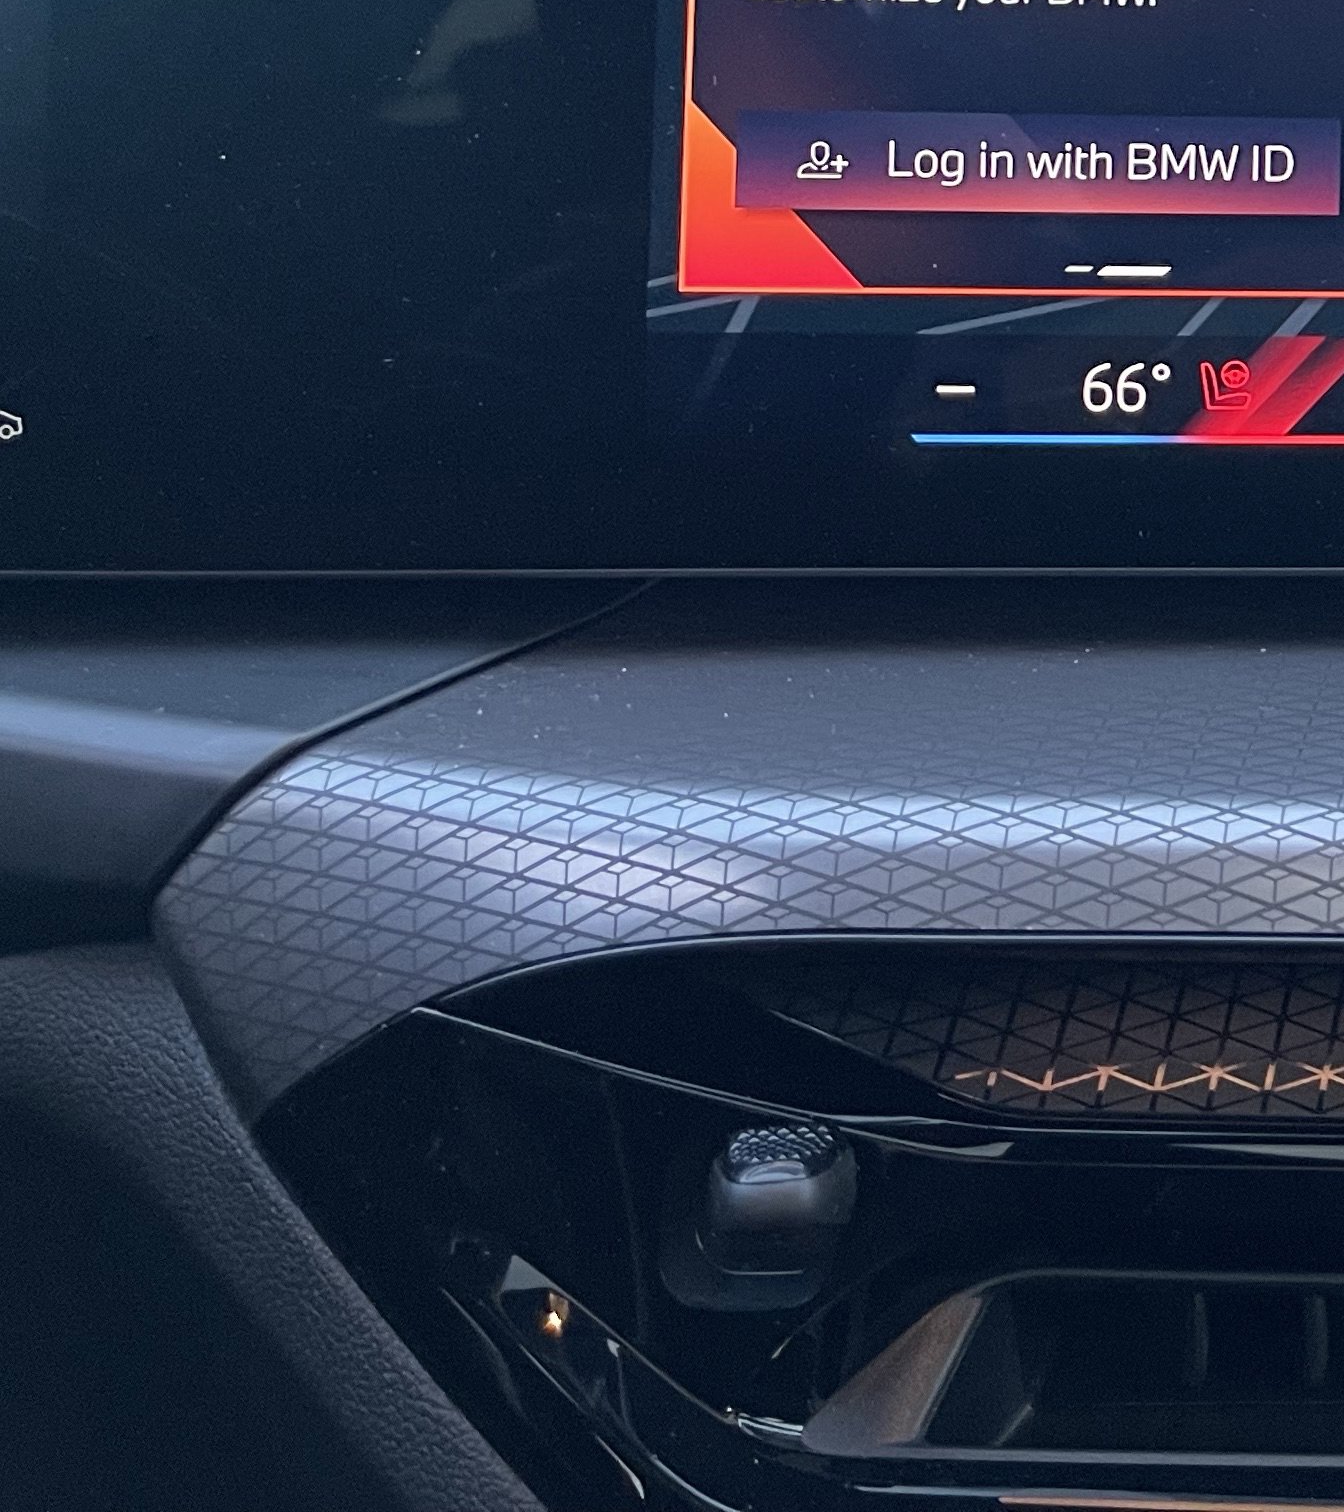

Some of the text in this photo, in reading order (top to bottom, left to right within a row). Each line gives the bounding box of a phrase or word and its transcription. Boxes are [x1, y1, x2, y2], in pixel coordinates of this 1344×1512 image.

[888, 139, 1295, 187] Log in with BMW ID
